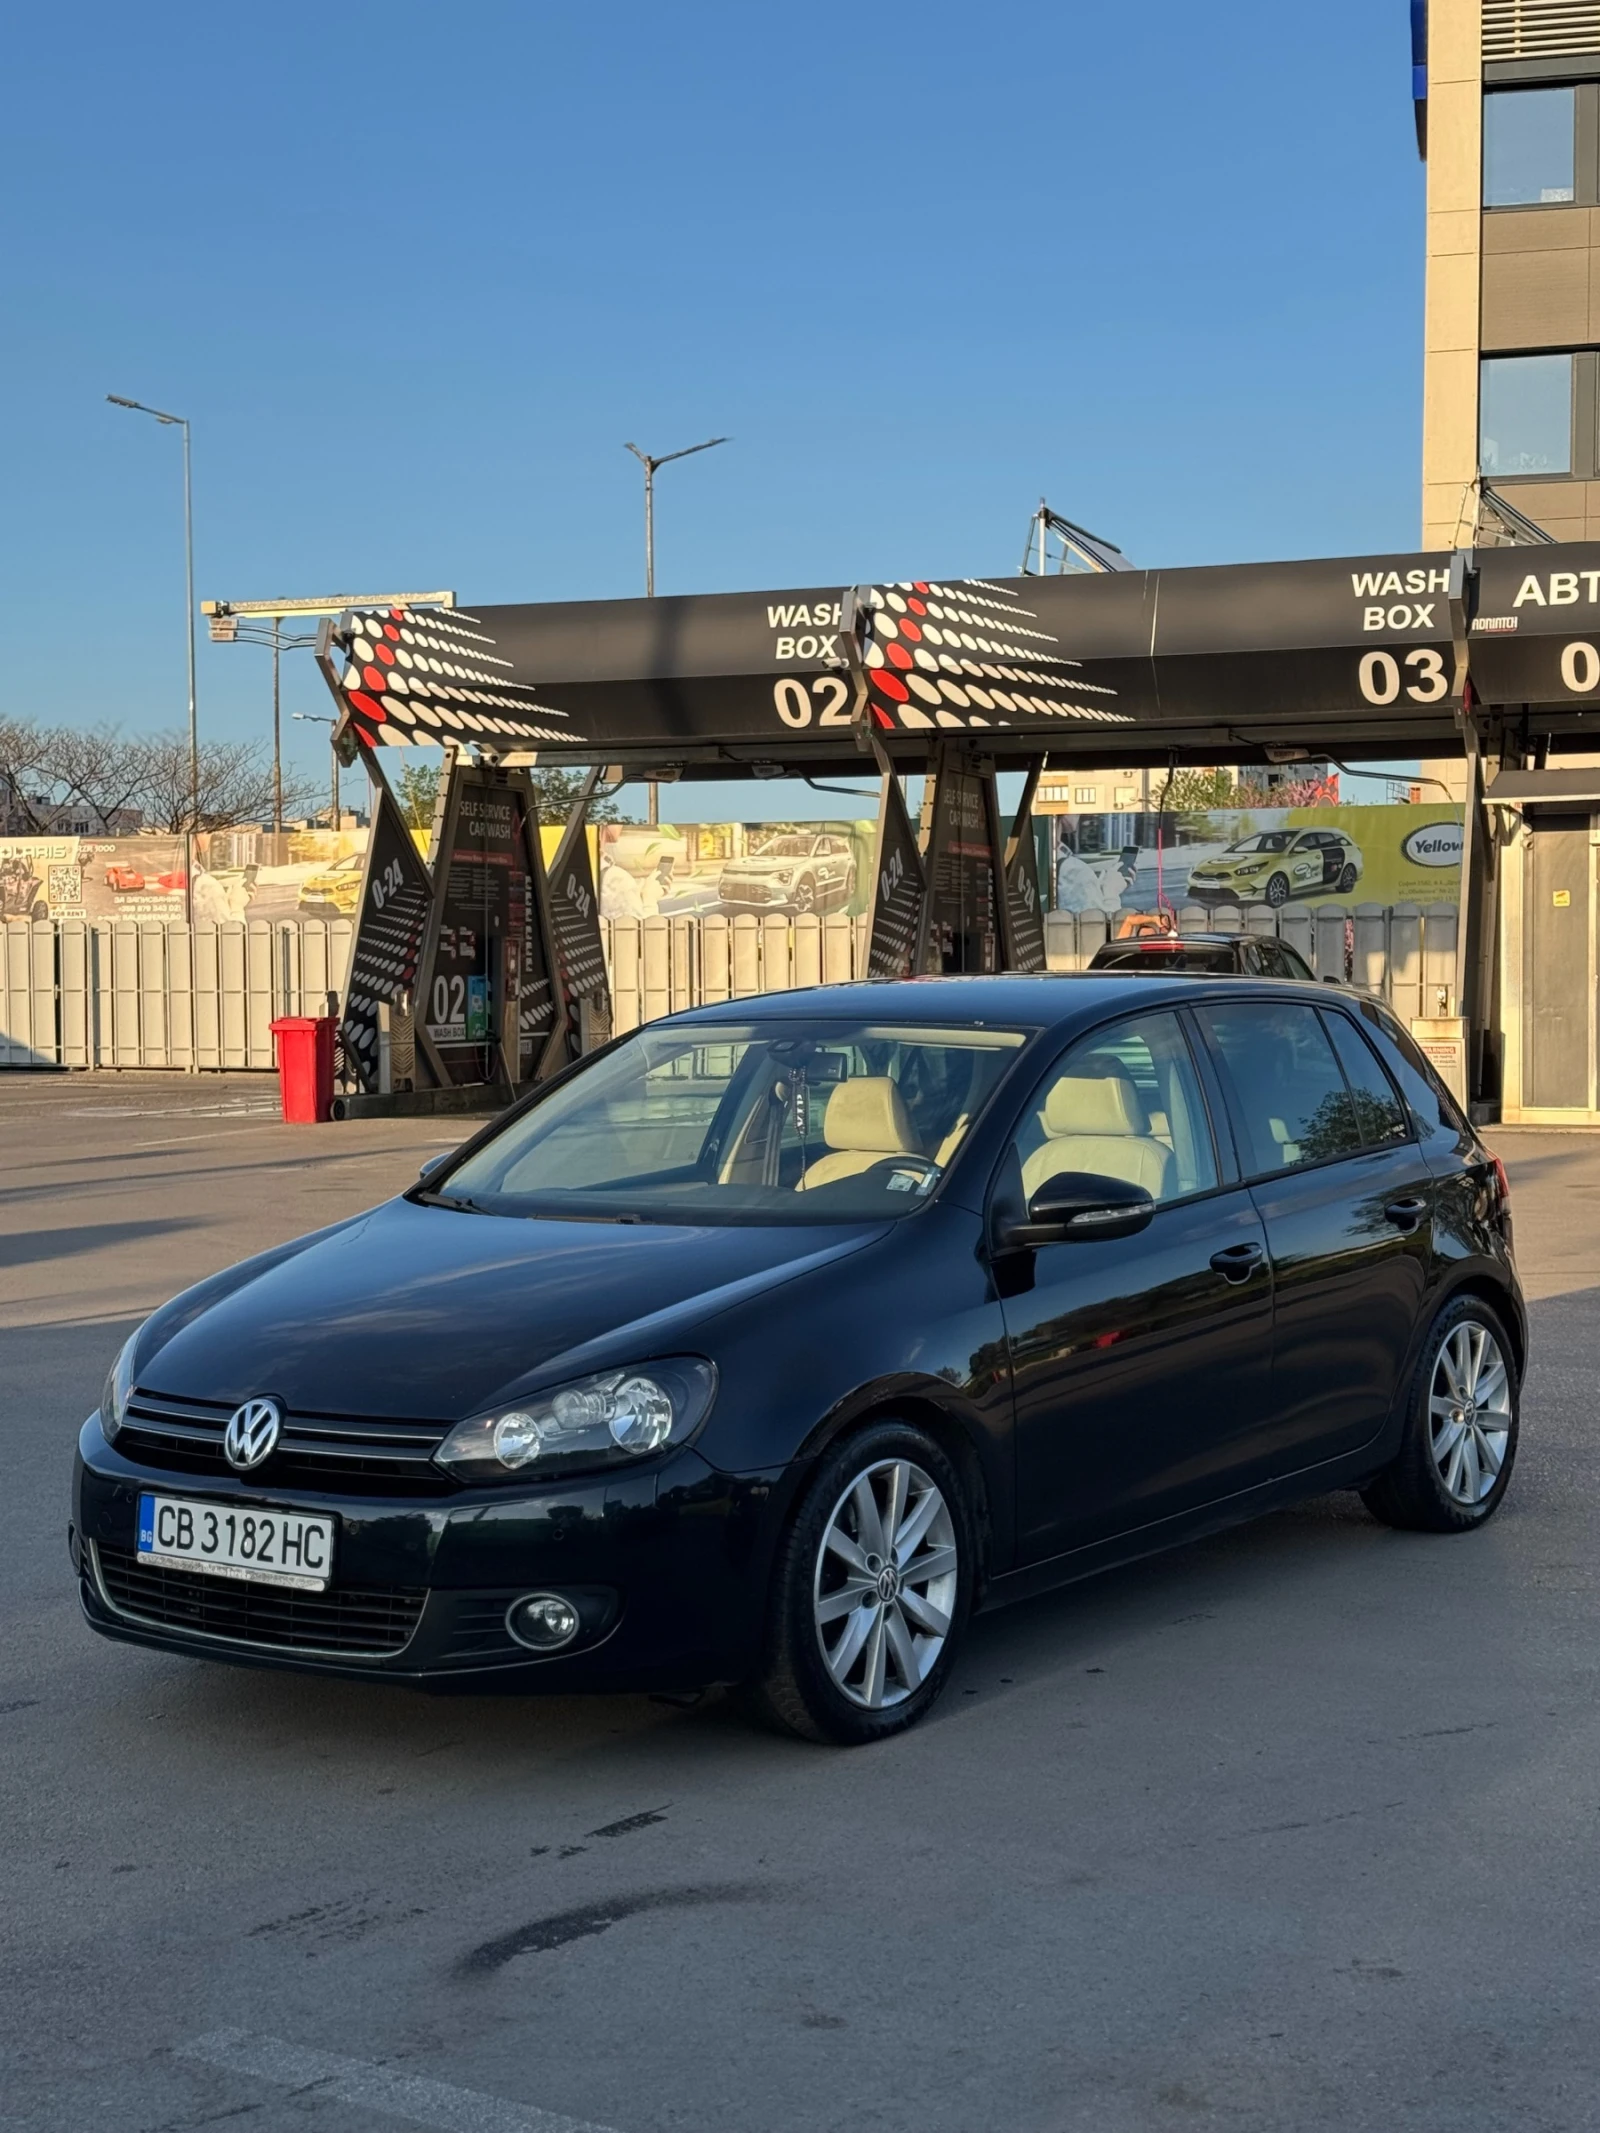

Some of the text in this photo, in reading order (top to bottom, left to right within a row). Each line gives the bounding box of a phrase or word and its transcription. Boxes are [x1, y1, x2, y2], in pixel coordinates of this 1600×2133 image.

[1352, 568, 1450, 597] WASH
[1363, 604, 1435, 632] BOX
[775, 635, 838, 660] BOX
[1359, 649, 1448, 706] 03
[774, 676, 852, 729] 02
[460, 801, 478, 817] SELF
[469, 821, 511, 840] CAR WASH
[1415, 839, 1463, 854] Yellow
[372, 858, 404, 909] 0-24
[881, 848, 904, 902] 0-24
[566, 874, 590, 919] 0-24
[1017, 866, 1035, 914] 0-24
[433, 975, 466, 1024] 02
[434, 1026, 466, 1039] WASH BOX
[141, 1529, 153, 1543] BG
